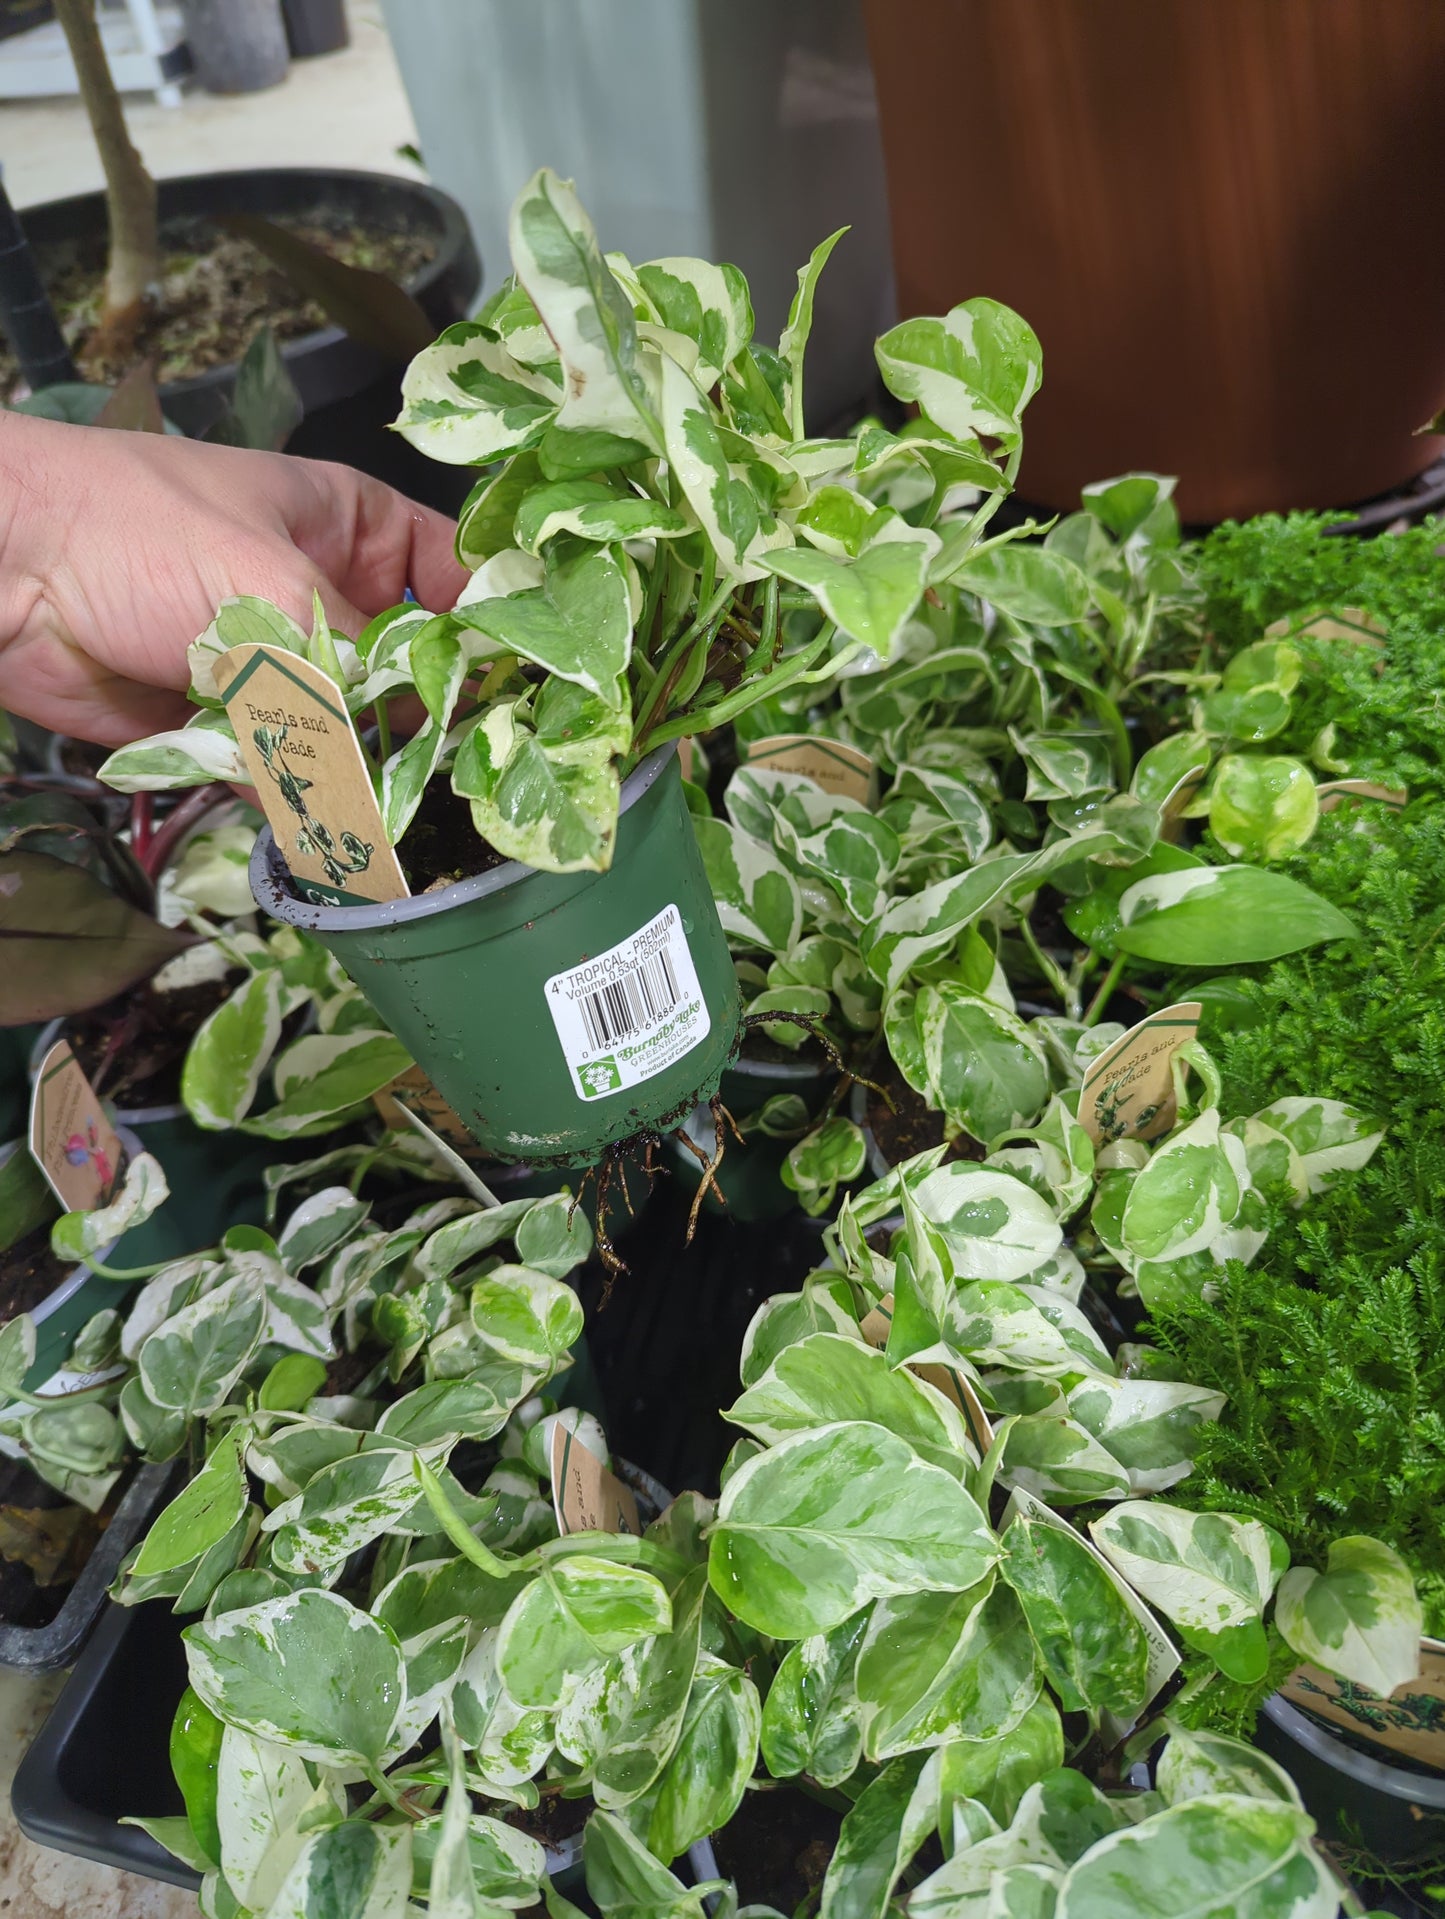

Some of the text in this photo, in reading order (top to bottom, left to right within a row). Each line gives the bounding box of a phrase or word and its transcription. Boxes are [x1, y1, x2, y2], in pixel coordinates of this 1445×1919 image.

[245, 704, 330, 734] Pearls and
[282, 737, 316, 759] Jade
[565, 931, 672, 1000] Volume 0.53qt (502ml)
[567, 951, 626, 989] TROPICAL
[632, 910, 676, 953] PREMIUM
[582, 991, 689, 1059] 0 64775 61886 0
[617, 1000, 700, 1061] Burnaby Lake
[630, 1016, 697, 1067] GREENHOUSES
[640, 1055, 667, 1077] Product
[675, 1036, 697, 1056] Canada
[1104, 1034, 1176, 1085] Pearls and
